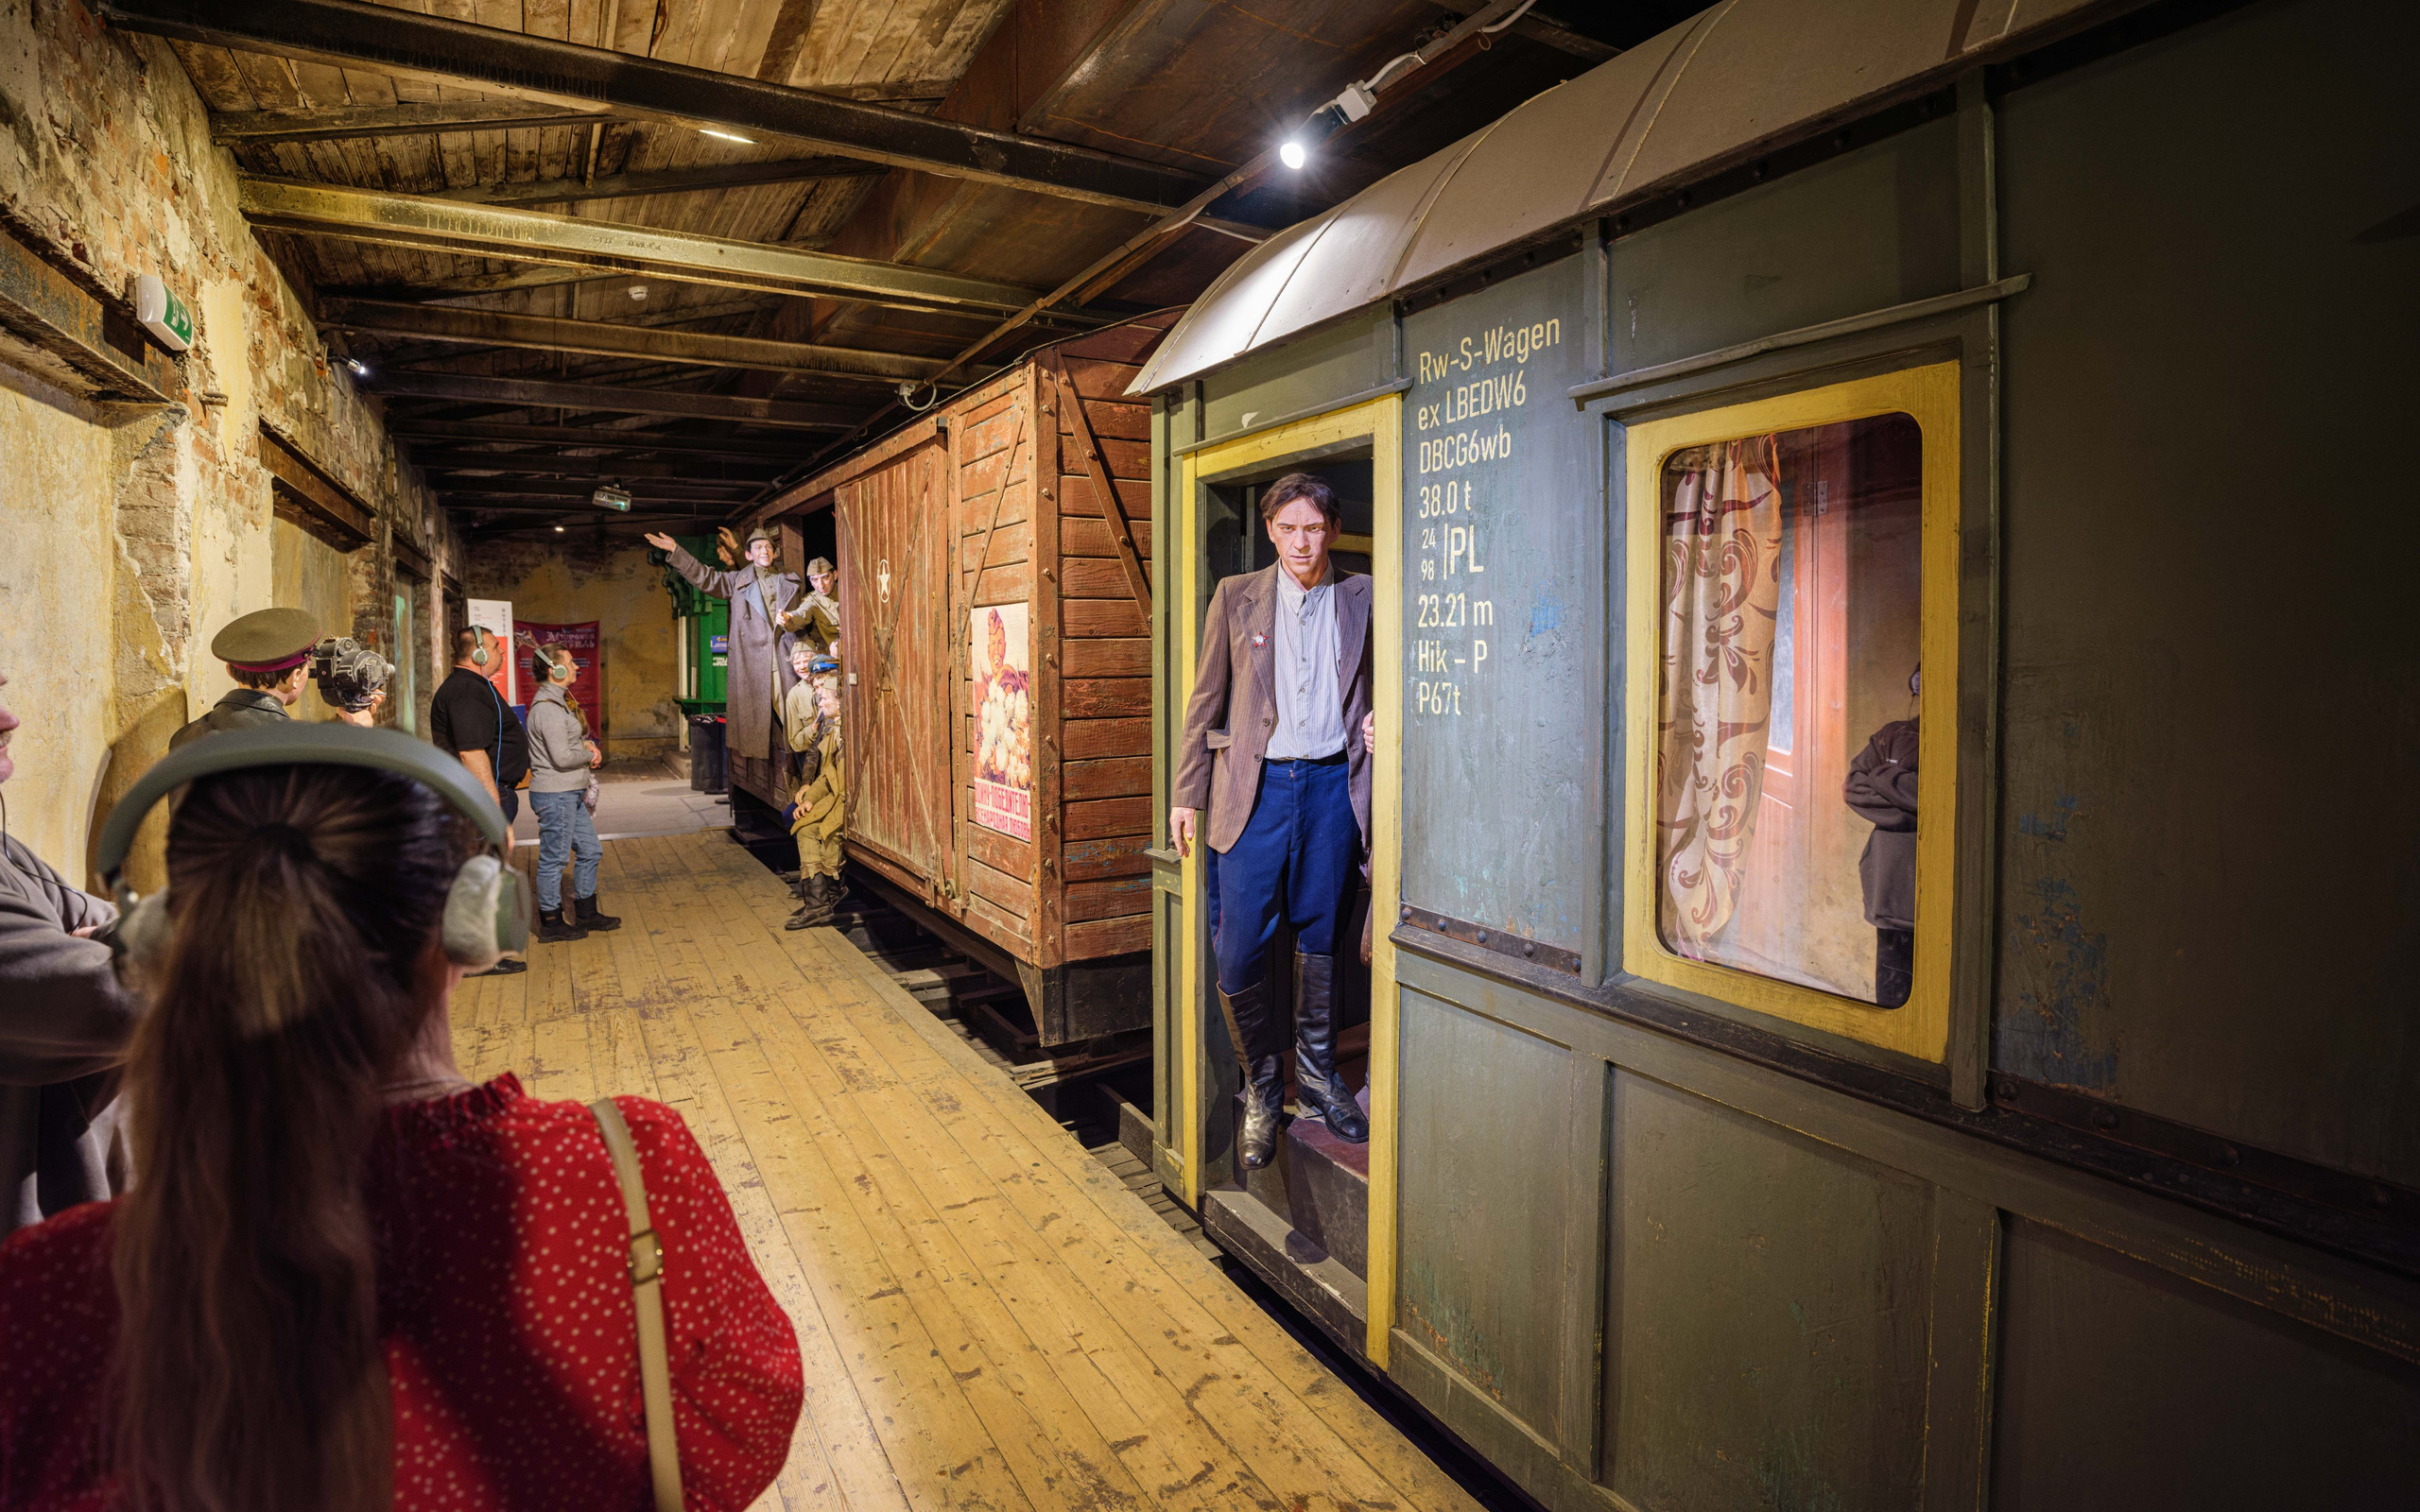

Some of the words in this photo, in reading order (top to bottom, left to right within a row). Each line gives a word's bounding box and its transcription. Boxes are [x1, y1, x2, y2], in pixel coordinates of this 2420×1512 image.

[1420, 318, 1561, 385] Rw-S-Wagen
[1418, 404, 1441, 431] ex
[1446, 369, 1527, 424] LBEDW6
[1420, 423, 1512, 474] DBCG6wb
[1419, 480, 1457, 519] 38.0
[1463, 480, 1472, 511] t
[1422, 528, 1436, 549] 24
[1421, 559, 1435, 582] 98
[1418, 593, 1467, 627] 23.21
[1473, 597, 1494, 626] m
[1418, 640, 1448, 673] Hik
[1474, 640, 1488, 674] P
[1419, 681, 1461, 715] P67t
